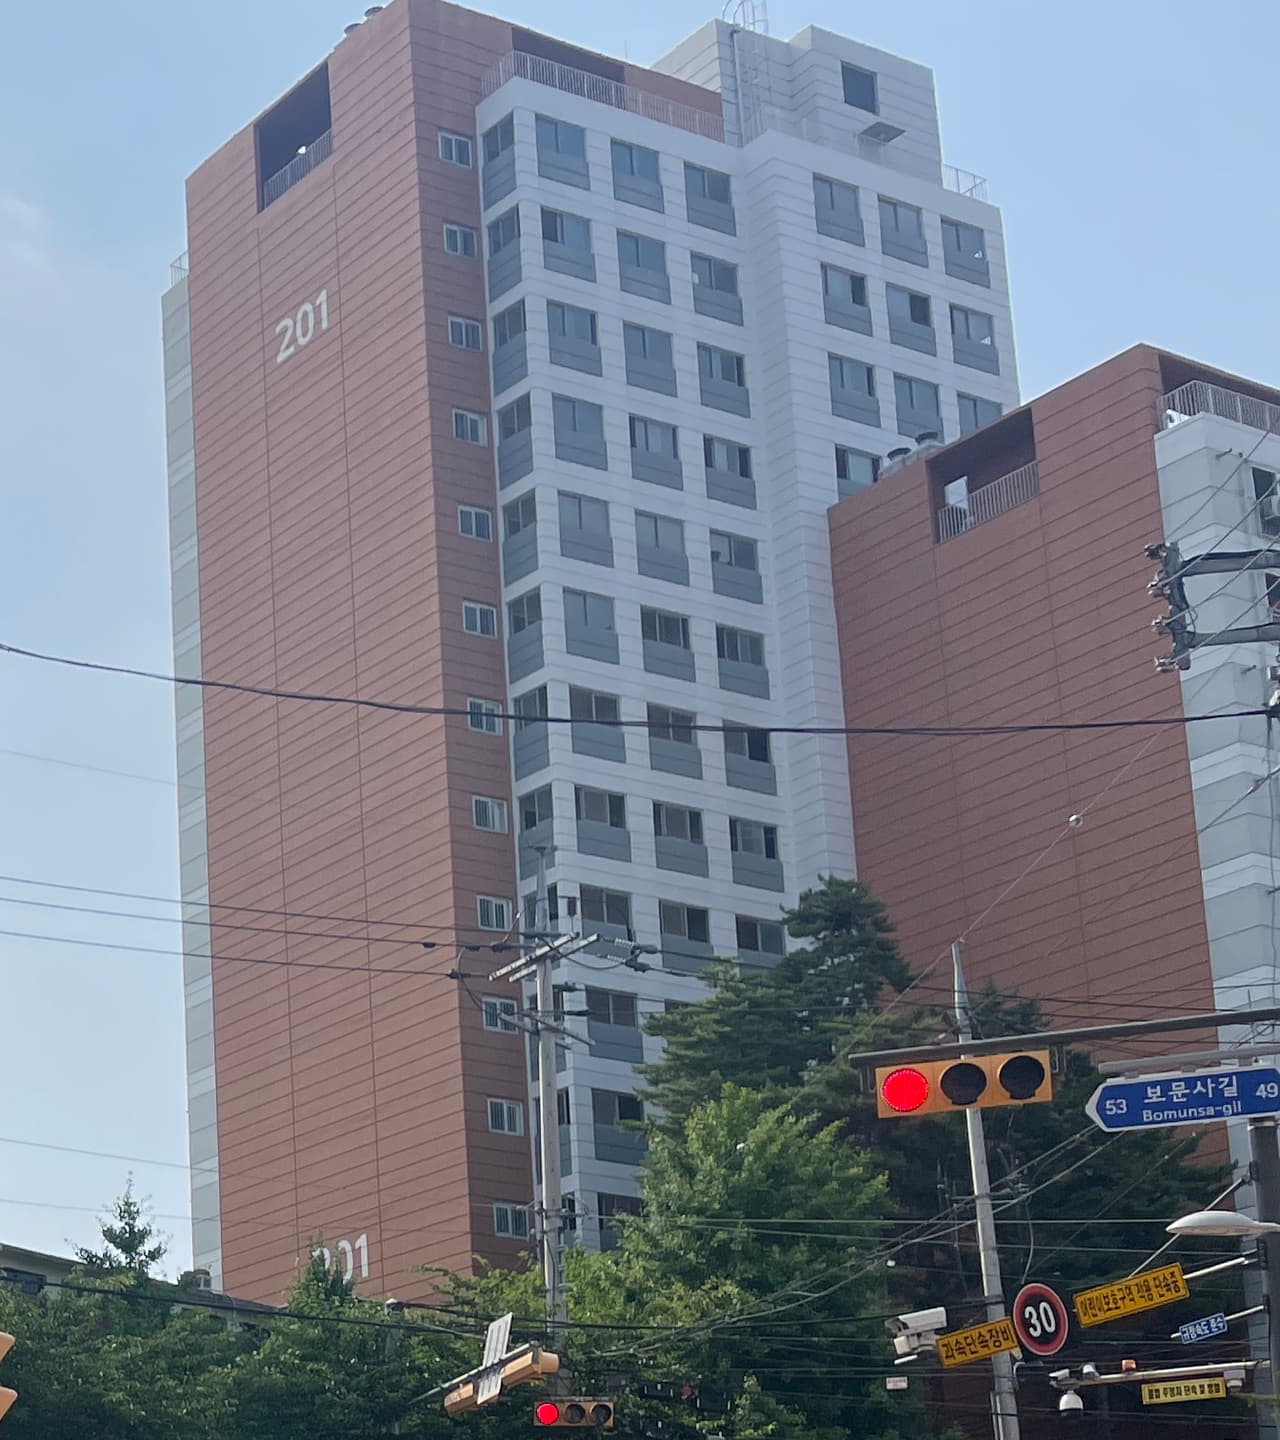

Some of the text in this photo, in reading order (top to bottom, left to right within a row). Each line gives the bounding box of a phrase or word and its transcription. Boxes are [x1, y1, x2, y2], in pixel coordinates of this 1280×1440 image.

[275, 289, 328, 363] 201
[1105, 1075, 1279, 1115] 53 보문사길 49
[1142, 1101, 1242, 1122] Bomunsa-gil
[1024, 1301, 1056, 1338] 30
[1080, 1287, 1134, 1320] 어린이보호구역
[943, 1322, 1015, 1361] 과속단속장비
